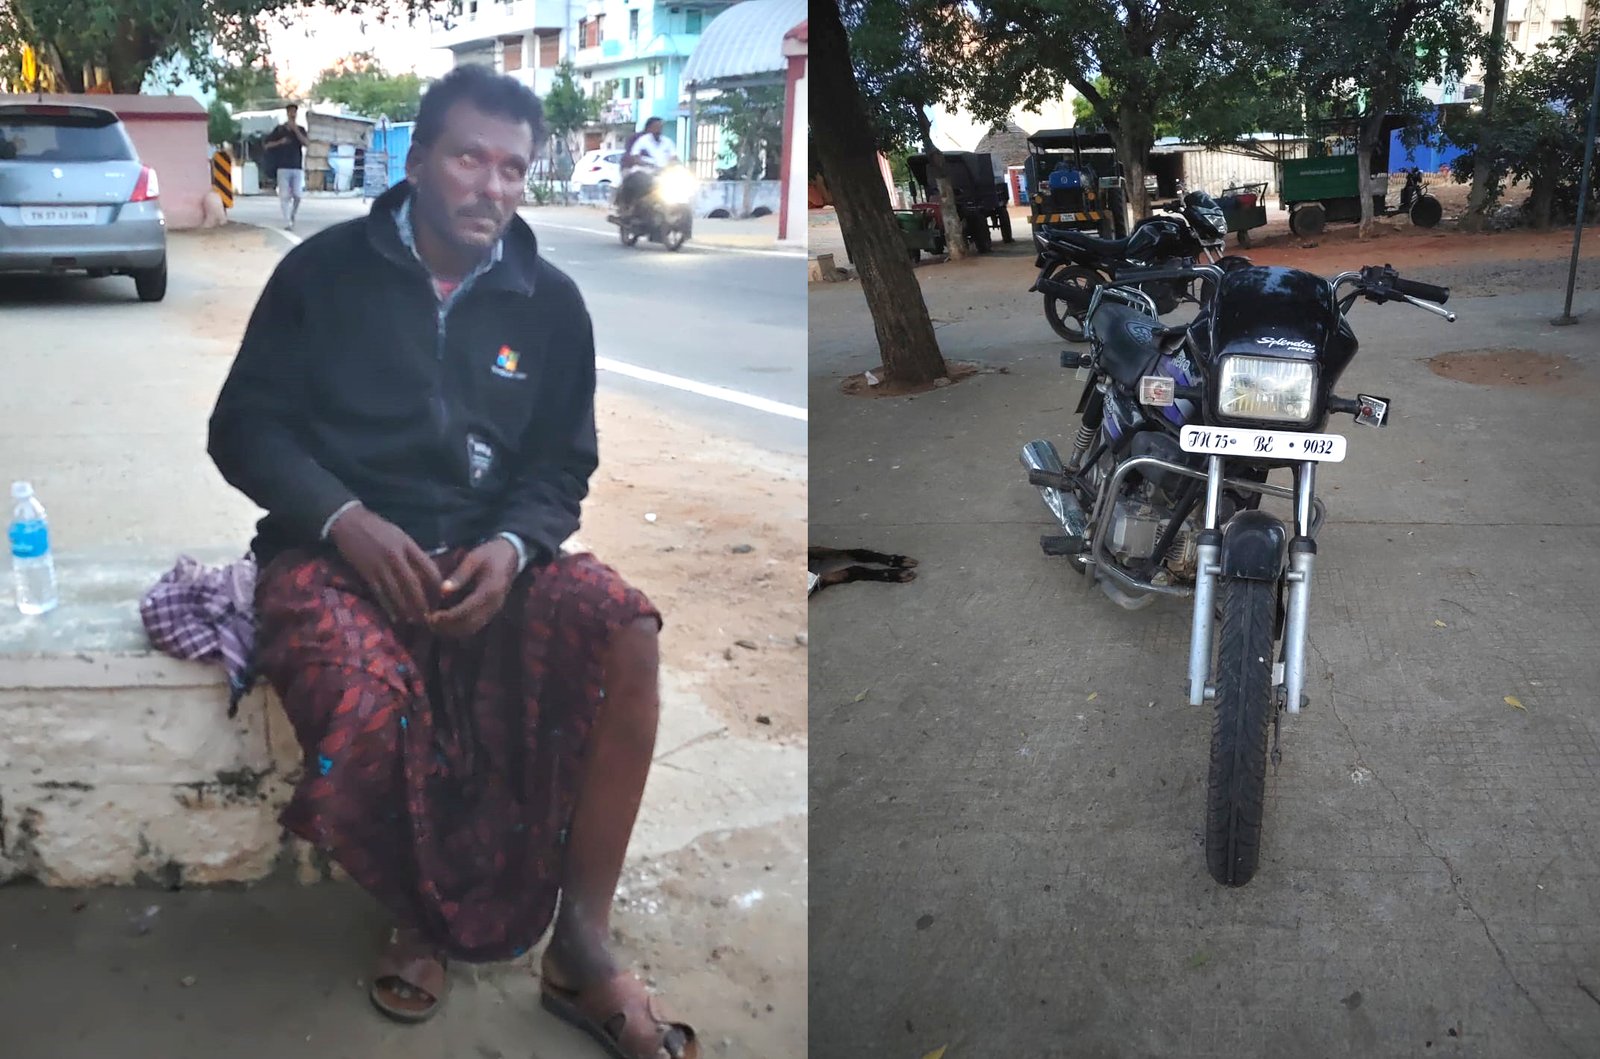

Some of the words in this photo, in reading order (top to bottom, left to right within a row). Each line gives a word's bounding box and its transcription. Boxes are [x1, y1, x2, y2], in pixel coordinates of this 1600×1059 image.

[1256, 336, 1316, 348] Splendor
[1214, 434, 1229, 449] 75
[1253, 435, 1274, 453] BE
[1302, 438, 1334, 455] 9032
